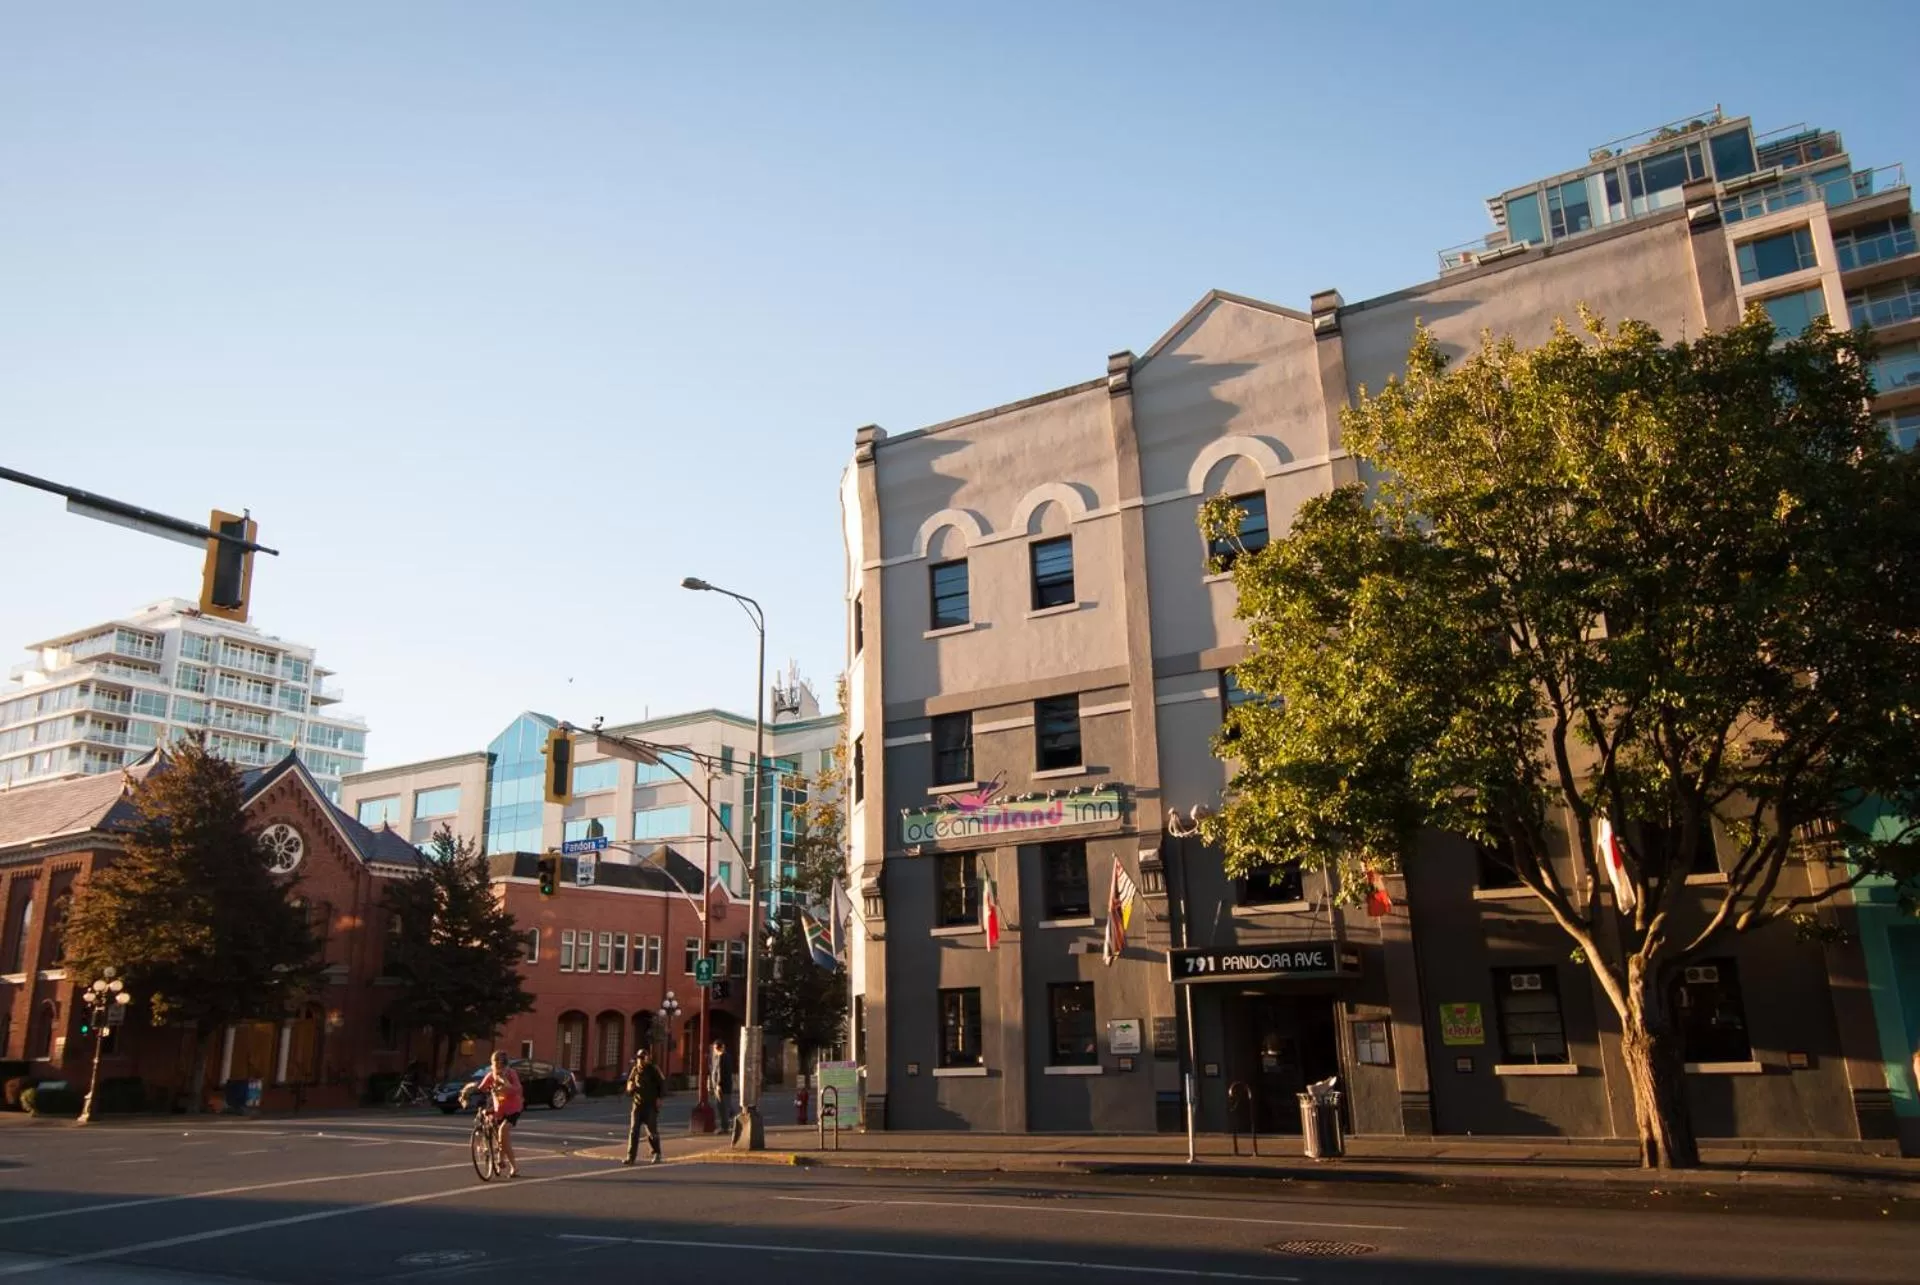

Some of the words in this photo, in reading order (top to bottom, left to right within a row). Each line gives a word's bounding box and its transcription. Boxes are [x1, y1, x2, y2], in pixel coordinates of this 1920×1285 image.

[907, 816, 982, 841] ocean
[982, 799, 1062, 832] island
[1074, 798, 1113, 822] inn
[564, 840, 596, 853] Pandora
[1185, 955, 1215, 973] 791
[1222, 953, 1291, 971] PANDORA
[1294, 951, 1327, 967] AVE.
